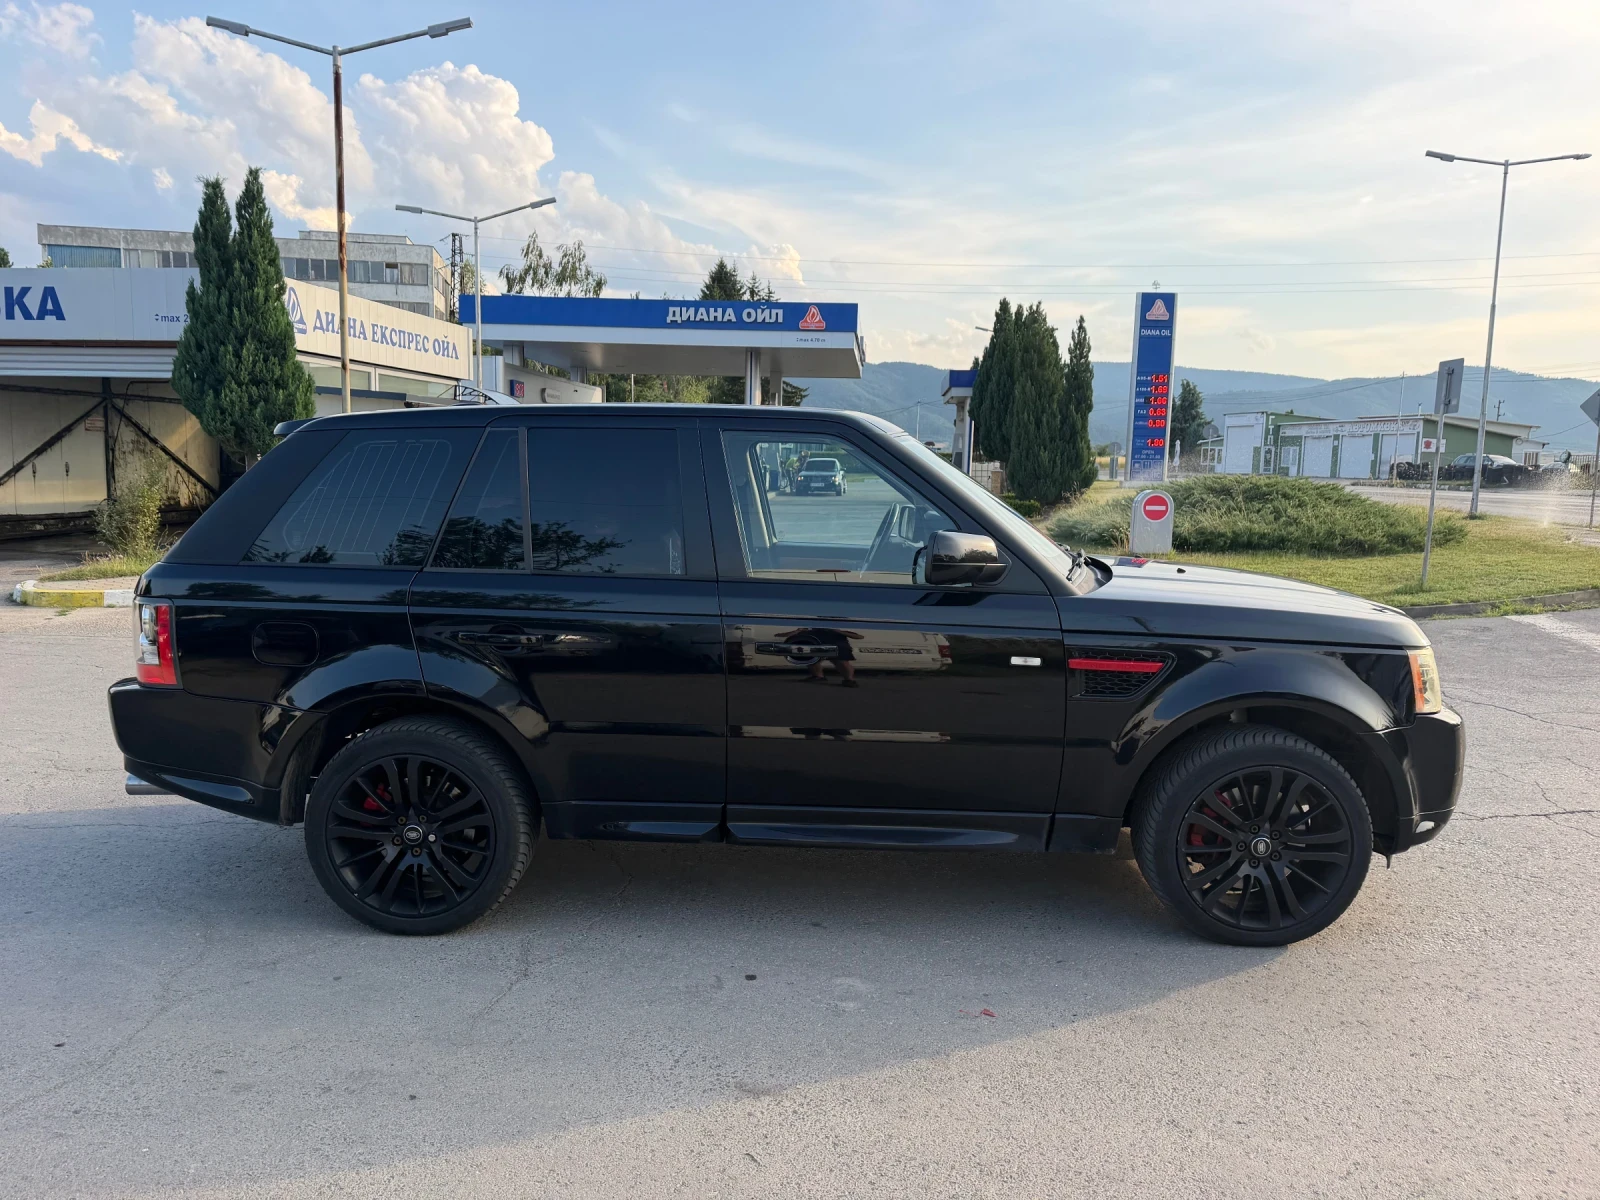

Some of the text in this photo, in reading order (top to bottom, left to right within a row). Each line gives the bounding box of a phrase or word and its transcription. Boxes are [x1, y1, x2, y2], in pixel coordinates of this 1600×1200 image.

[0, 286, 67, 321] КА
[666, 305, 784, 324] ДИАНА ОЙЛ
[313, 309, 460, 360] ДИНА ЕКСПРЕС ОЙЛ
